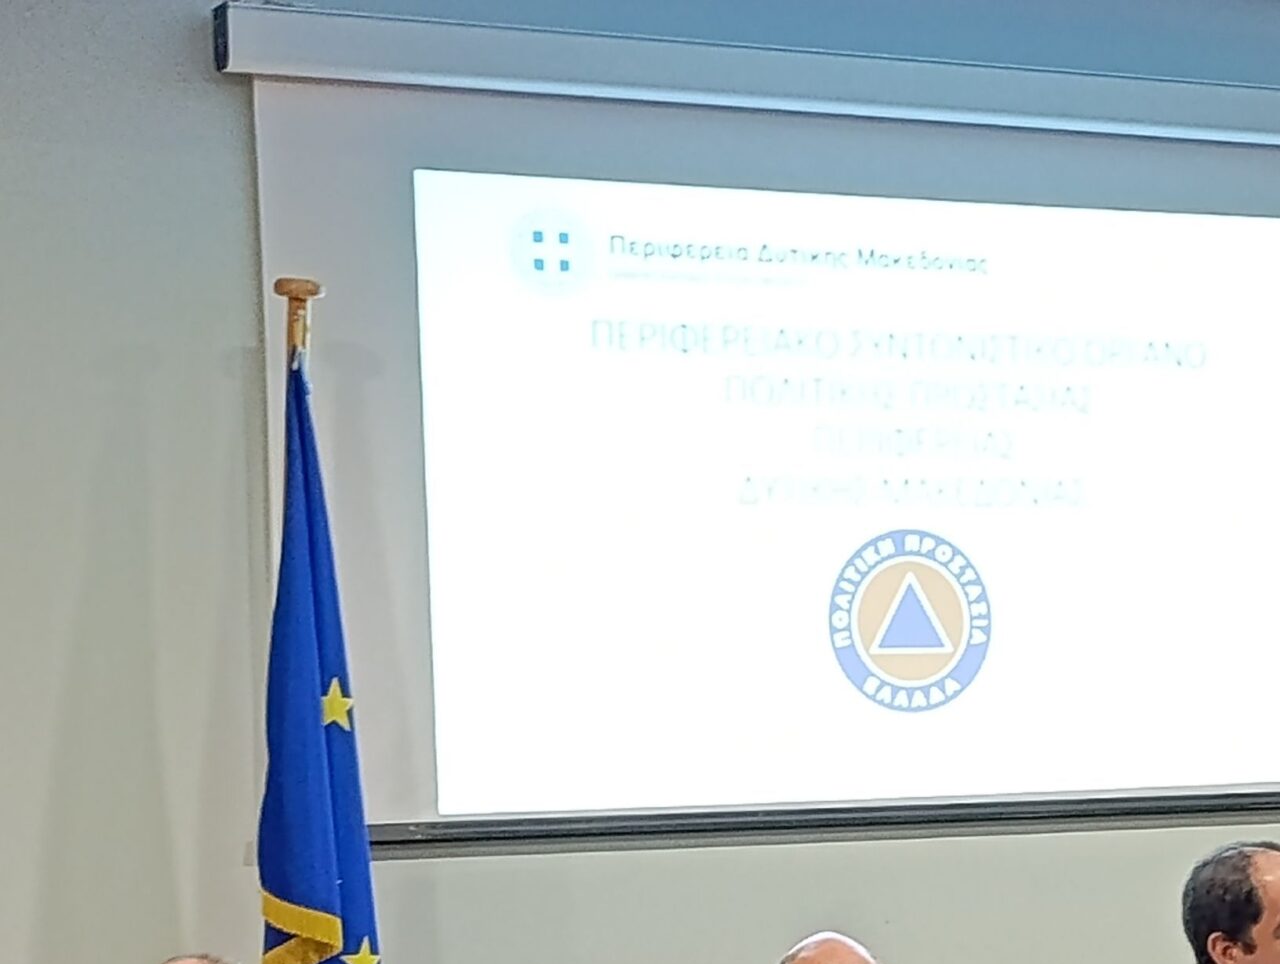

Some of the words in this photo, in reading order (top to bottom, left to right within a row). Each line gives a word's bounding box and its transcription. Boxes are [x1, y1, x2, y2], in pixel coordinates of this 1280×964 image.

[591, 319, 840, 359] ΠΕΡΙΦΕΡΕΙΑΚΟ
[832, 538, 896, 648] ΠΟΛΙΤΙΚΗ
[904, 534, 989, 645] ΠΡΟΣΤΑΣΙΑ
